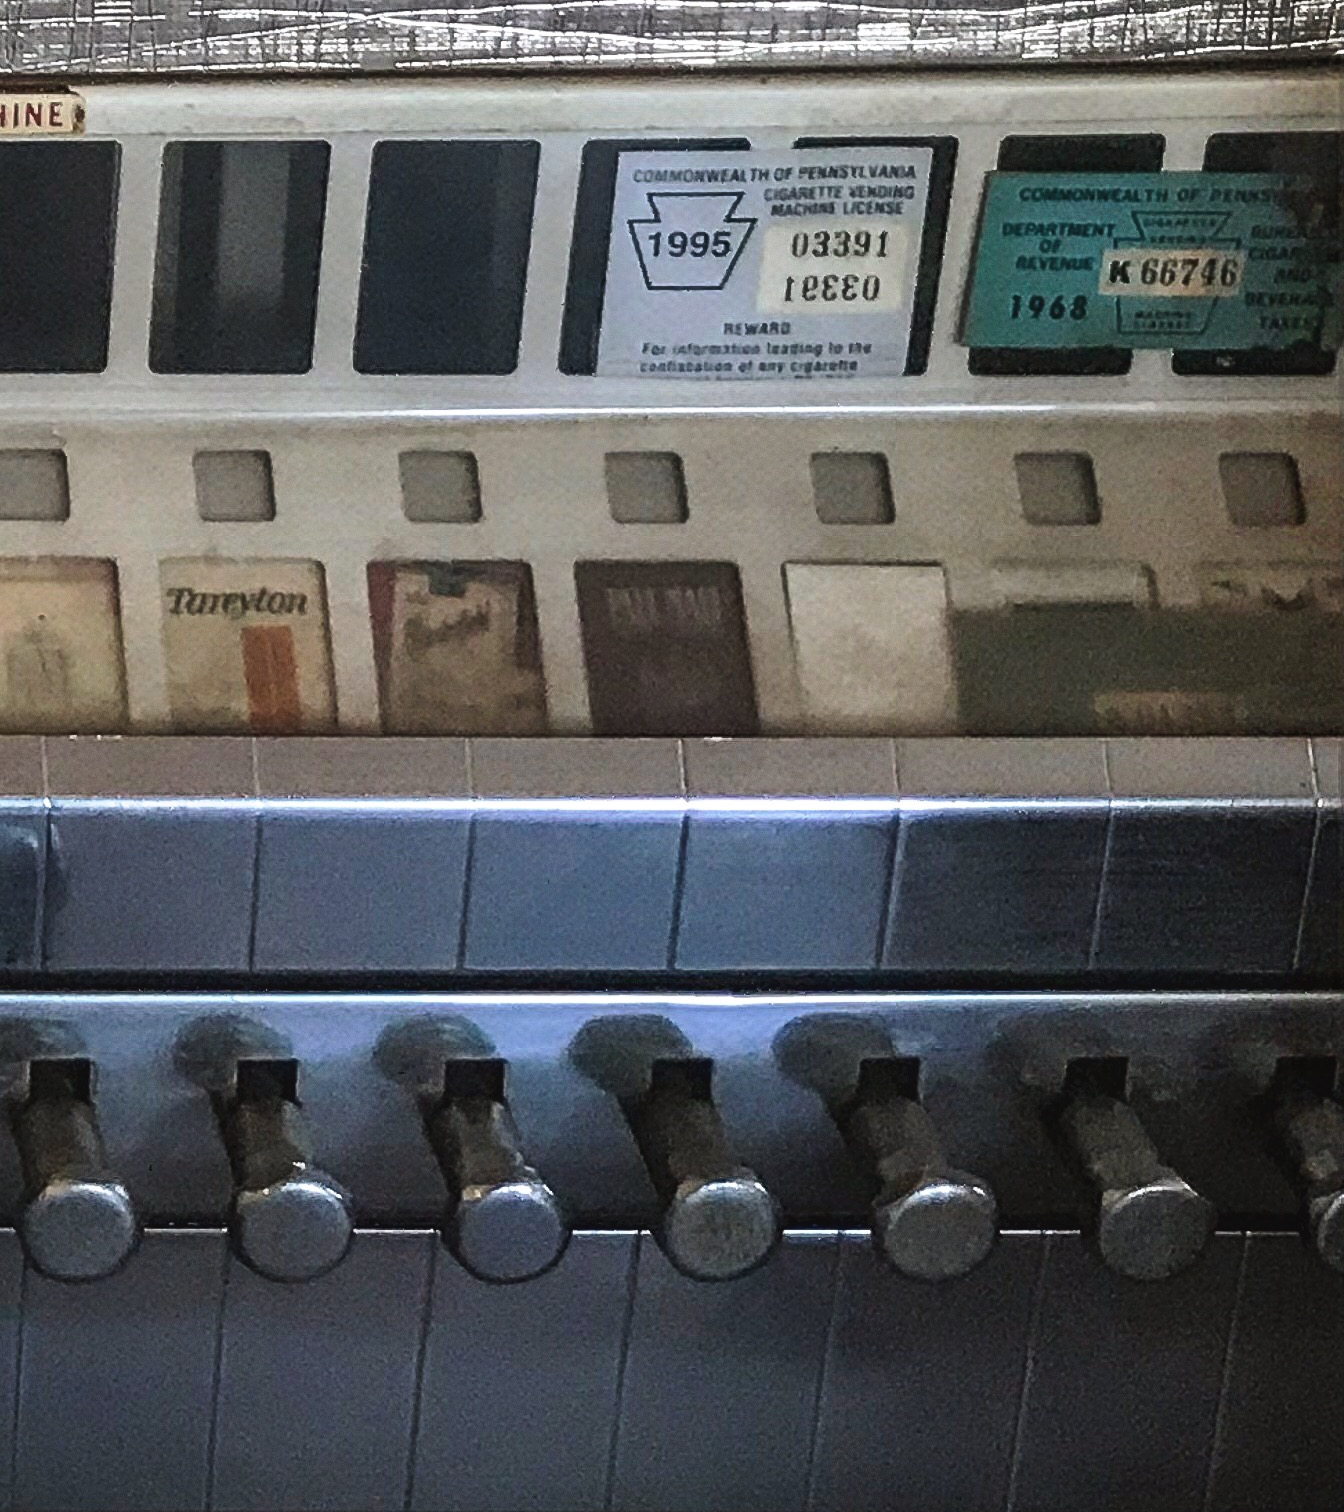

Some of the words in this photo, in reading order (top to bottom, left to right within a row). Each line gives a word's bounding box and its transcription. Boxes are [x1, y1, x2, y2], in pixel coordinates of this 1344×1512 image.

[633, 167, 769, 183] COMMONWEALTH
[774, 166, 793, 182] OF
[798, 165, 917, 180] PENNSYLVANIA
[764, 185, 844, 202] CIGARETTE
[1018, 187, 1168, 204] COMMONWEALTH
[1177, 188, 1200, 204] OF
[843, 199, 905, 216] LICENSE
[1002, 222, 1115, 238] DEPARTMENT
[648, 230, 733, 258] 1995
[790, 230, 889, 259] 03391
[1039, 239, 1061, 254] OF
[1015, 257, 1095, 272] REVENUE
[1109, 261, 1131, 285] K
[1141, 258, 1238, 287] 66746
[1011, 294, 1089, 321] 1968
[723, 322, 792, 336] REWARD
[166, 586, 309, 620] Tareyton
